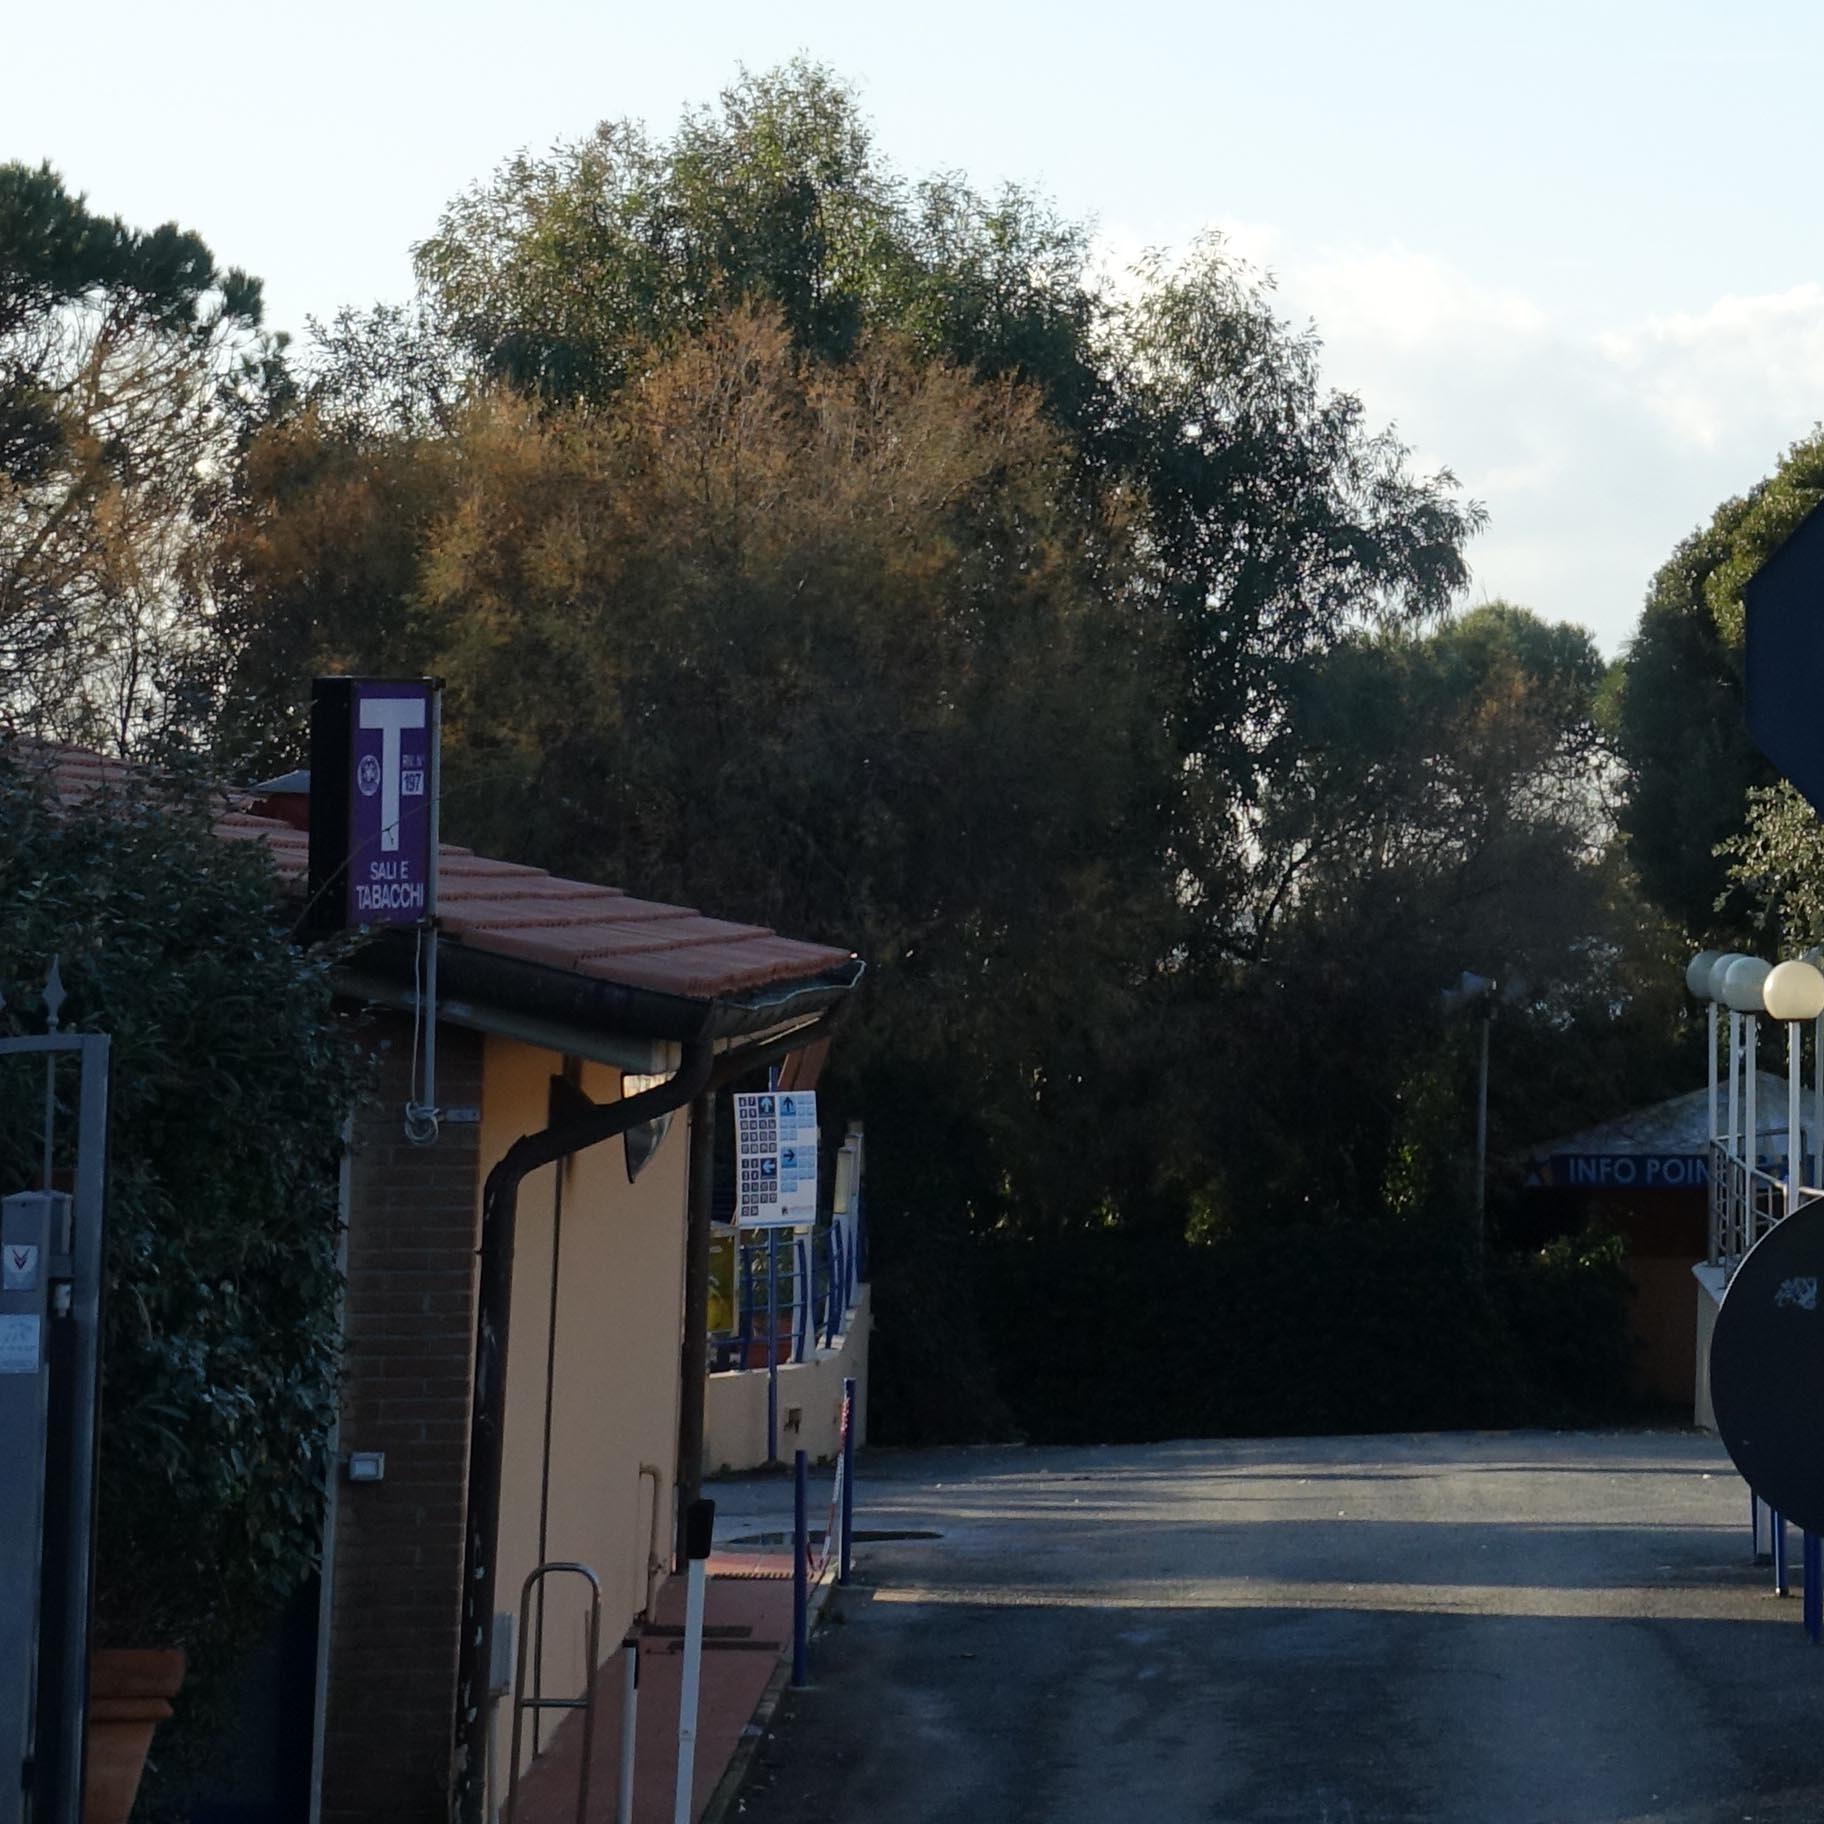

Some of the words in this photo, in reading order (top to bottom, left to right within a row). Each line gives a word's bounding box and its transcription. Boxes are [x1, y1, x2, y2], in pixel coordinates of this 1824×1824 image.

[359, 698, 425, 852] T
[404, 773, 422, 793] 197
[370, 862, 396, 880] SALI
[400, 861, 409, 879] E
[356, 884, 424, 910] TABACCHI
[1569, 1157, 1636, 1183] INFO
[1646, 1158, 1709, 1184] POIN
